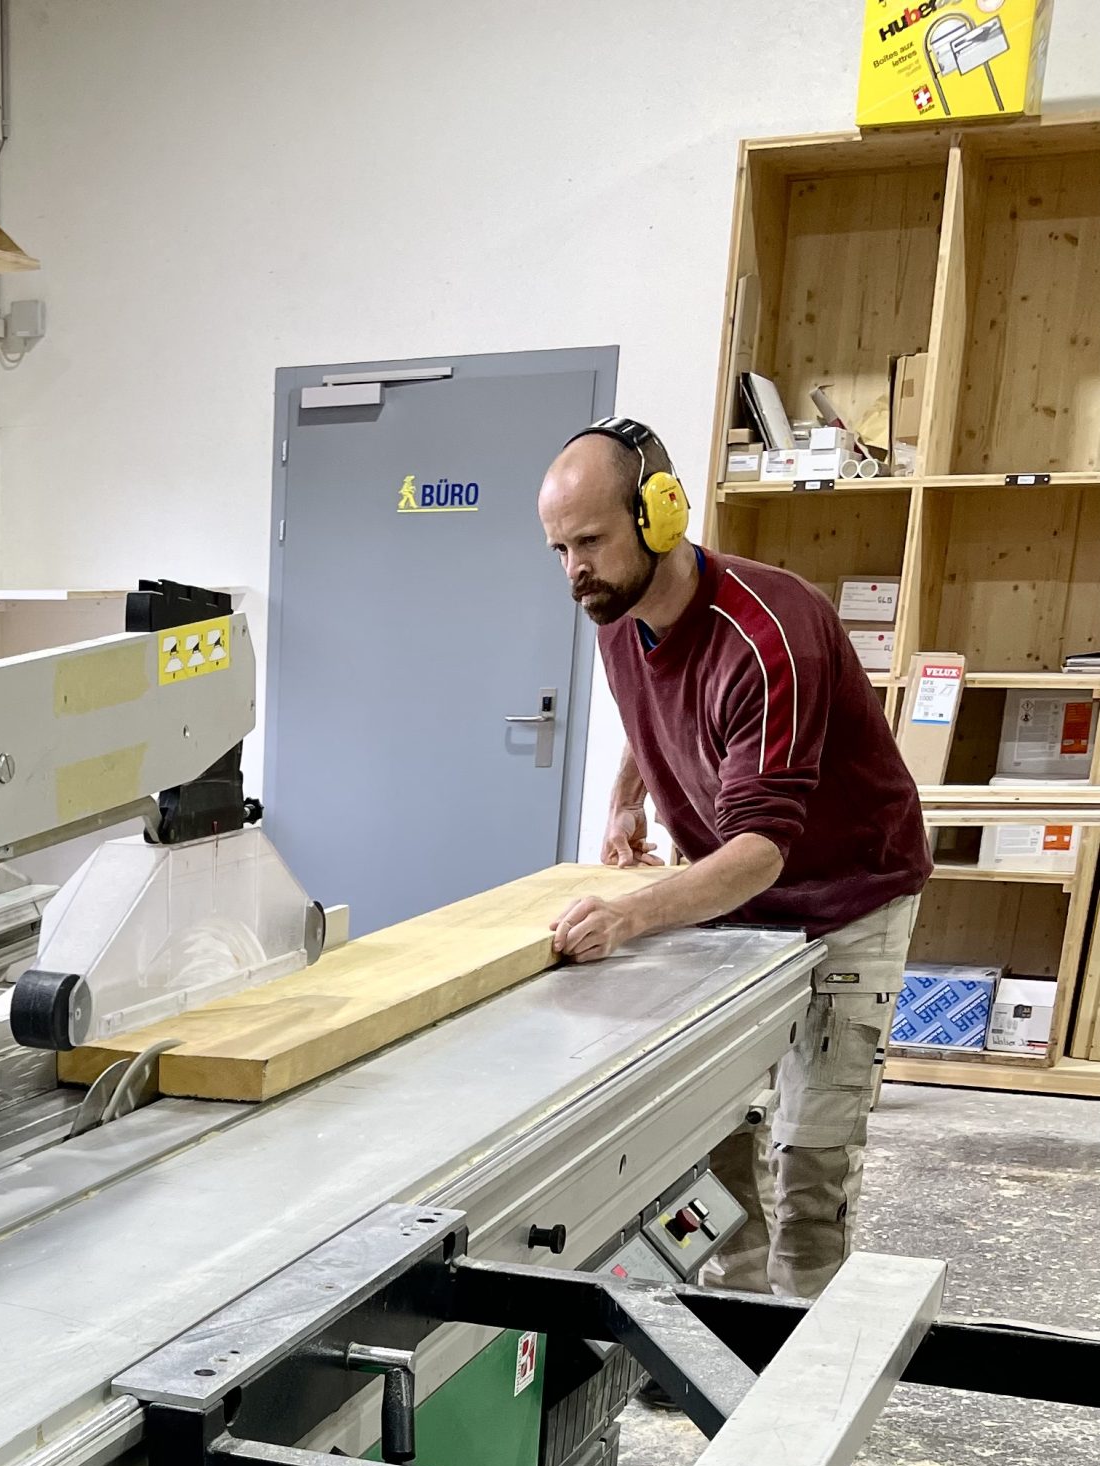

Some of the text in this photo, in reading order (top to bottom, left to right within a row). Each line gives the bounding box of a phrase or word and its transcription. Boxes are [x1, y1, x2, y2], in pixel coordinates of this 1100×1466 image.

[421, 479, 479, 507] BÜRO
[925, 667, 959, 678] VELUX
[918, 988, 960, 1024] FEHR
